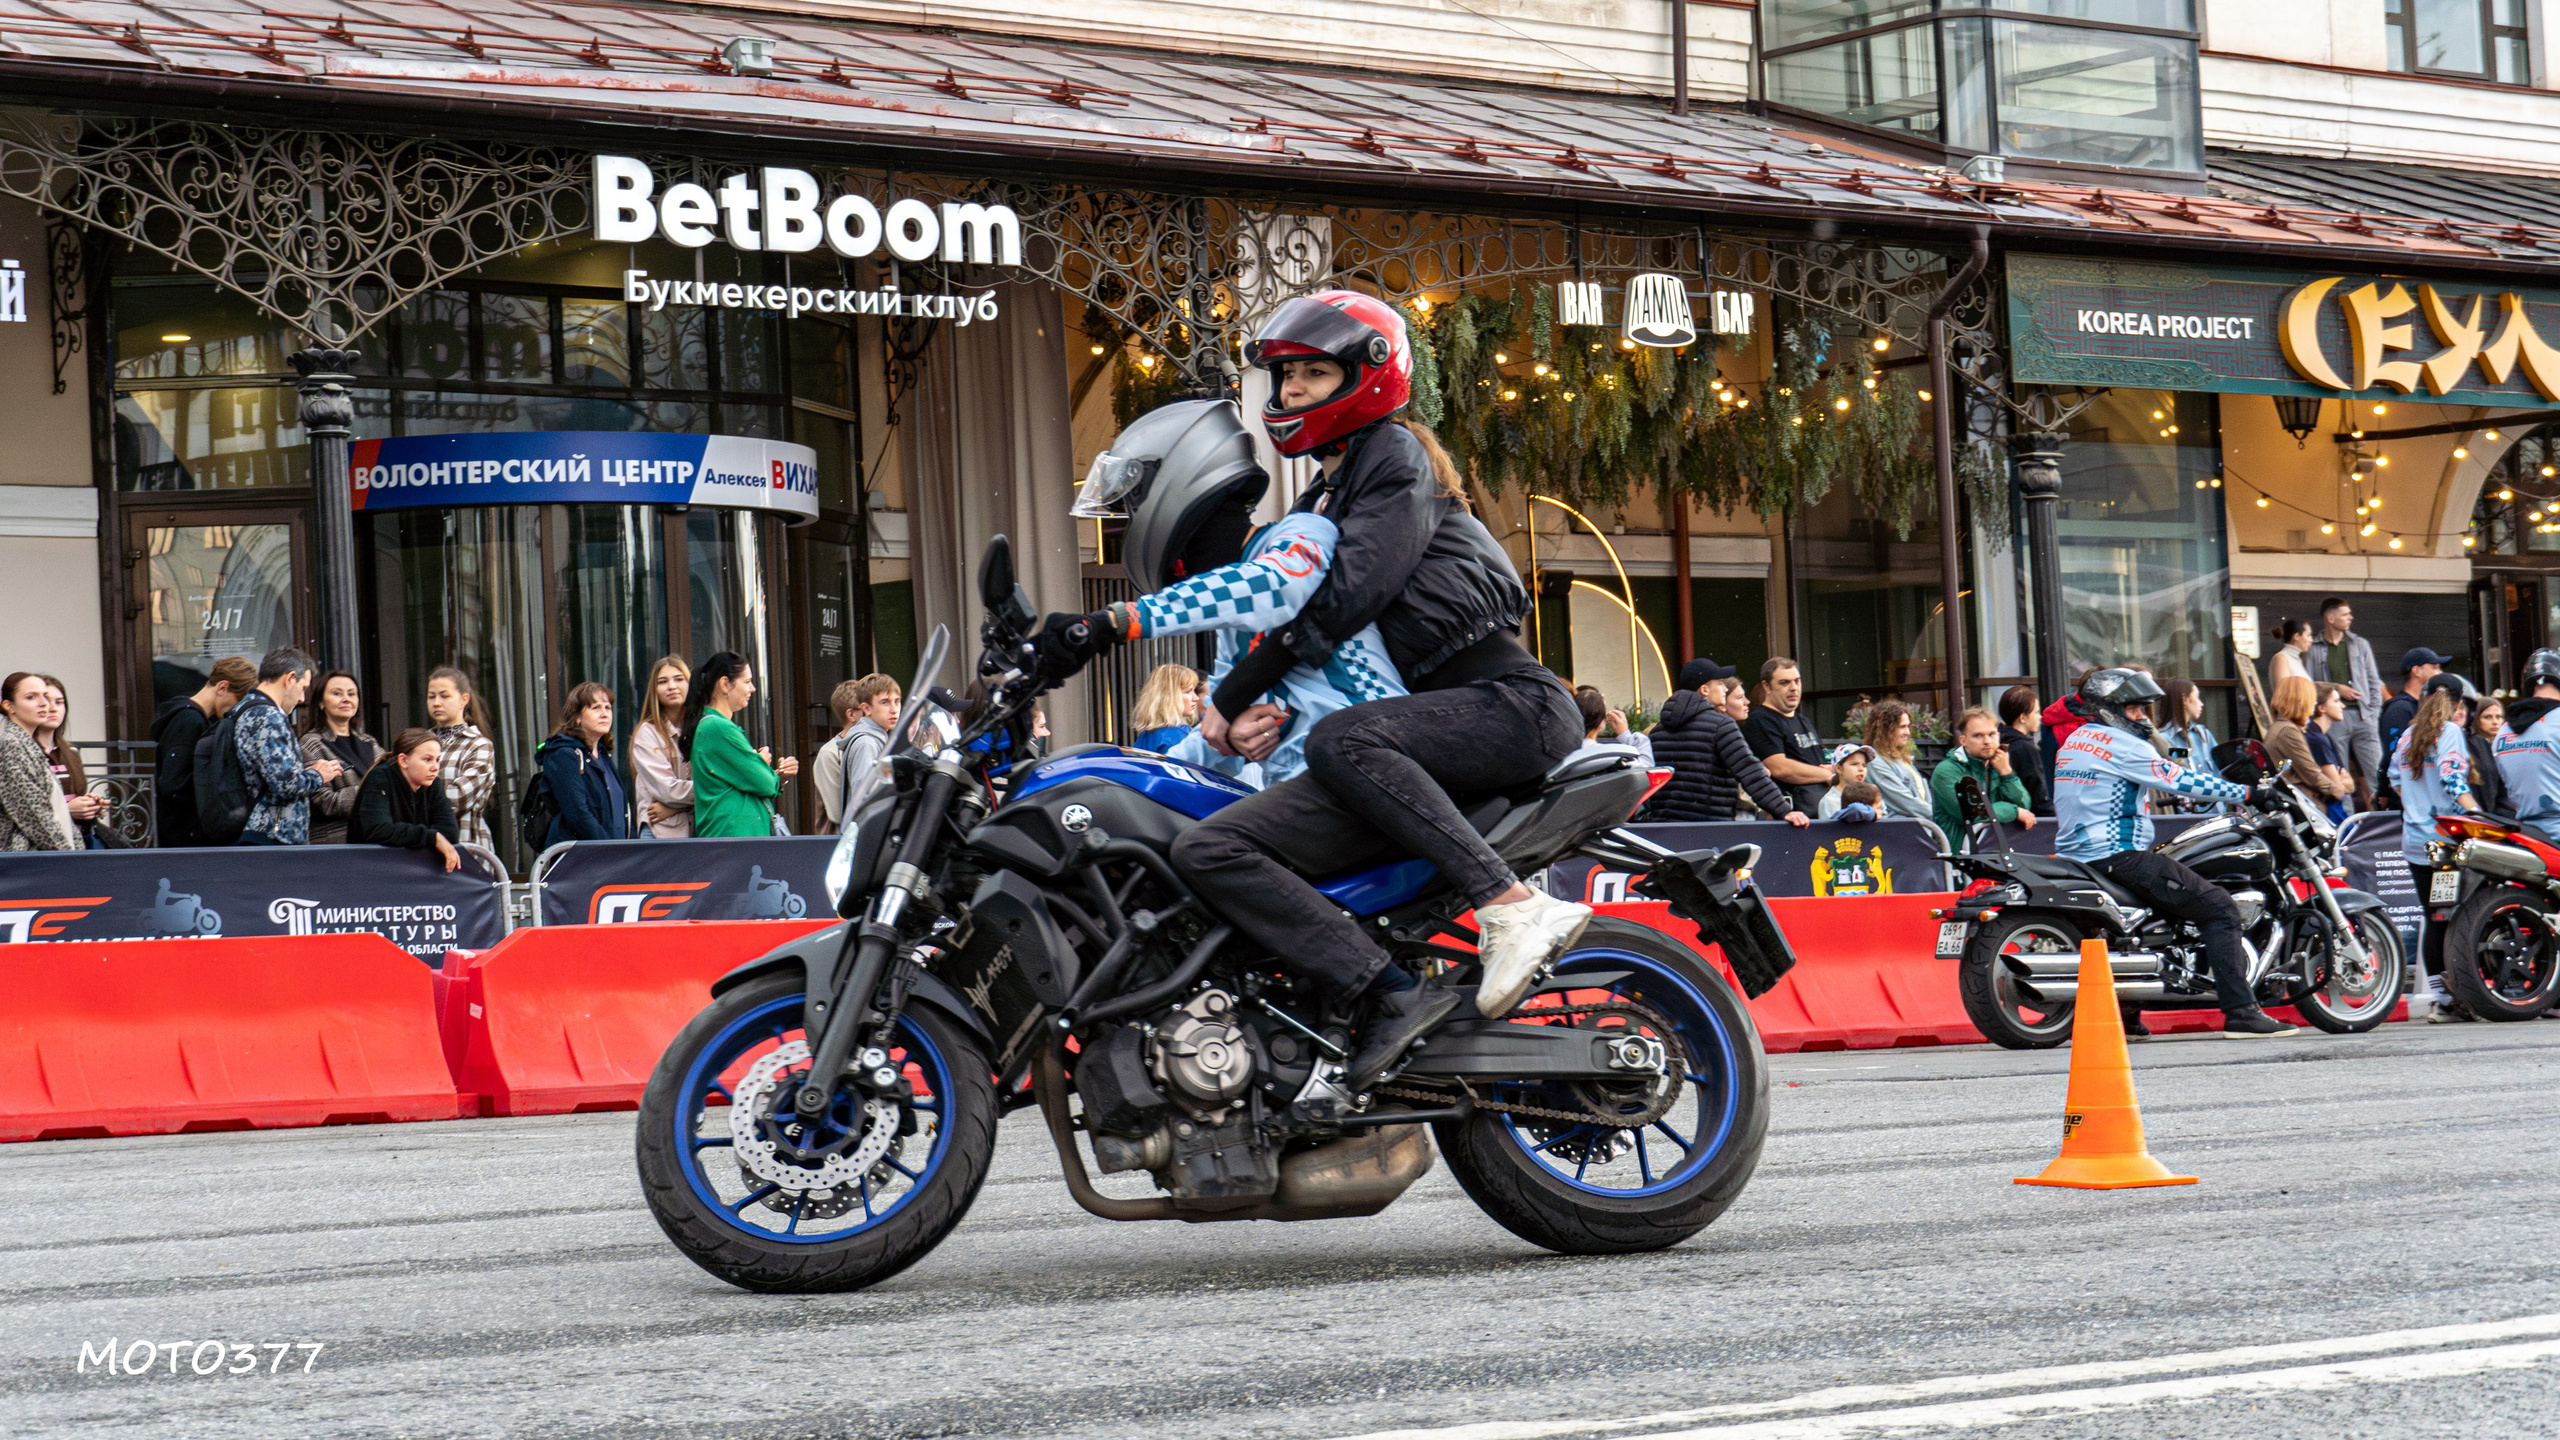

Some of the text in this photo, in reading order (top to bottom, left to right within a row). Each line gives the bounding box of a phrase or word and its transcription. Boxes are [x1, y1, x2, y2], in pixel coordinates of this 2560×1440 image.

[592, 155, 1021, 266] BetBoom
[624, 269, 999, 327] Букмекерский клуб
[1559, 281, 1603, 326] BAR
[1631, 275, 1694, 330] ЛАМПА
[1711, 291, 1754, 334] БАР
[2077, 309, 2254, 340] KOREA PROJECT
[354, 454, 695, 491] ВОЛОНТЕРСКИЙ ЦЕНТР
[704, 467, 767, 488] Алексея
[202, 608, 243, 631] 24/7
[2063, 740, 2113, 762] SANDER
[2393, 868, 2411, 876] ПОС
[315, 904, 457, 925] МИНИСТЕРСТВО
[1943, 924, 1963, 936] 2691
[407, 943, 459, 955] ОБЛАСТИ
[1951, 941, 1962, 953] 66
